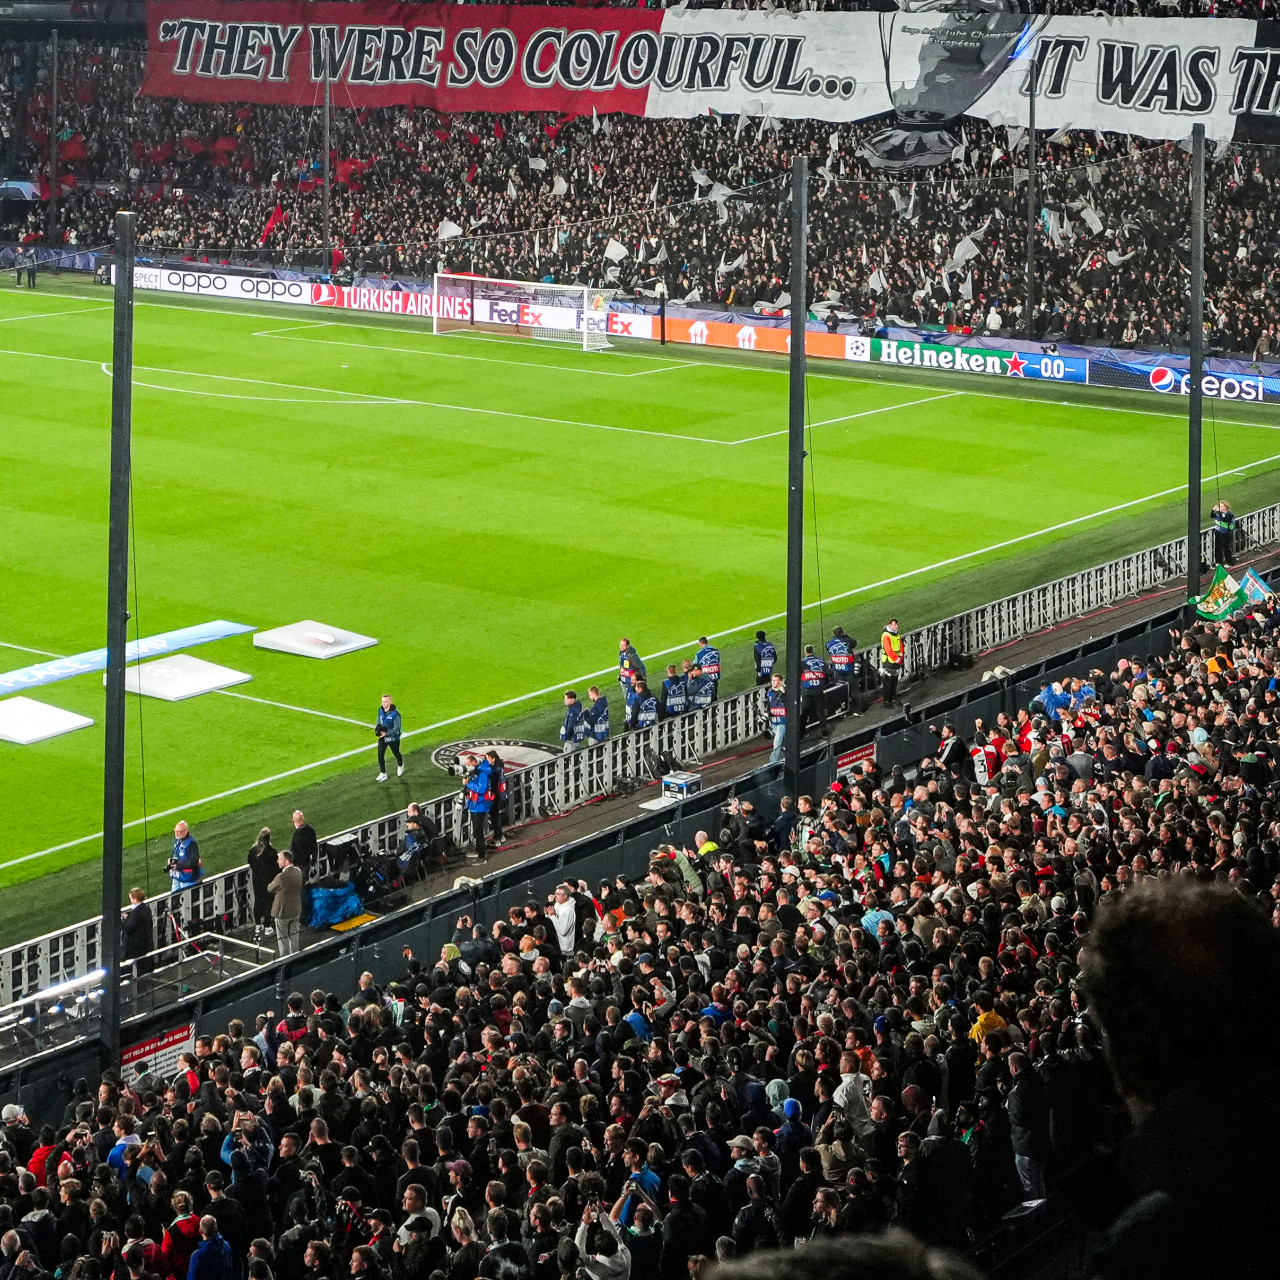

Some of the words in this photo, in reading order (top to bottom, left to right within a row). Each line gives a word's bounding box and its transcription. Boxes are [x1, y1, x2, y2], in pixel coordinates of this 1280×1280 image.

[309, 23, 444, 87] WERE
[447, 27, 516, 89] SO
[1023, 34, 1089, 98] IT
[1098, 39, 1220, 114] WAS
[134, 272, 159, 283] SPECT
[168, 272, 227, 292] oppo
[241, 279, 302, 300] oppo
[341, 286, 402, 313] TURKISH
[406, 293, 472, 320] AIRLINES
[489, 302, 542, 326] FedEx
[576, 310, 632, 335] FedEx
[880, 340, 1002, 374] Heineken
[1040, 358, 1064, 379] 0.0
[1181, 375, 1264, 401] pepsi
